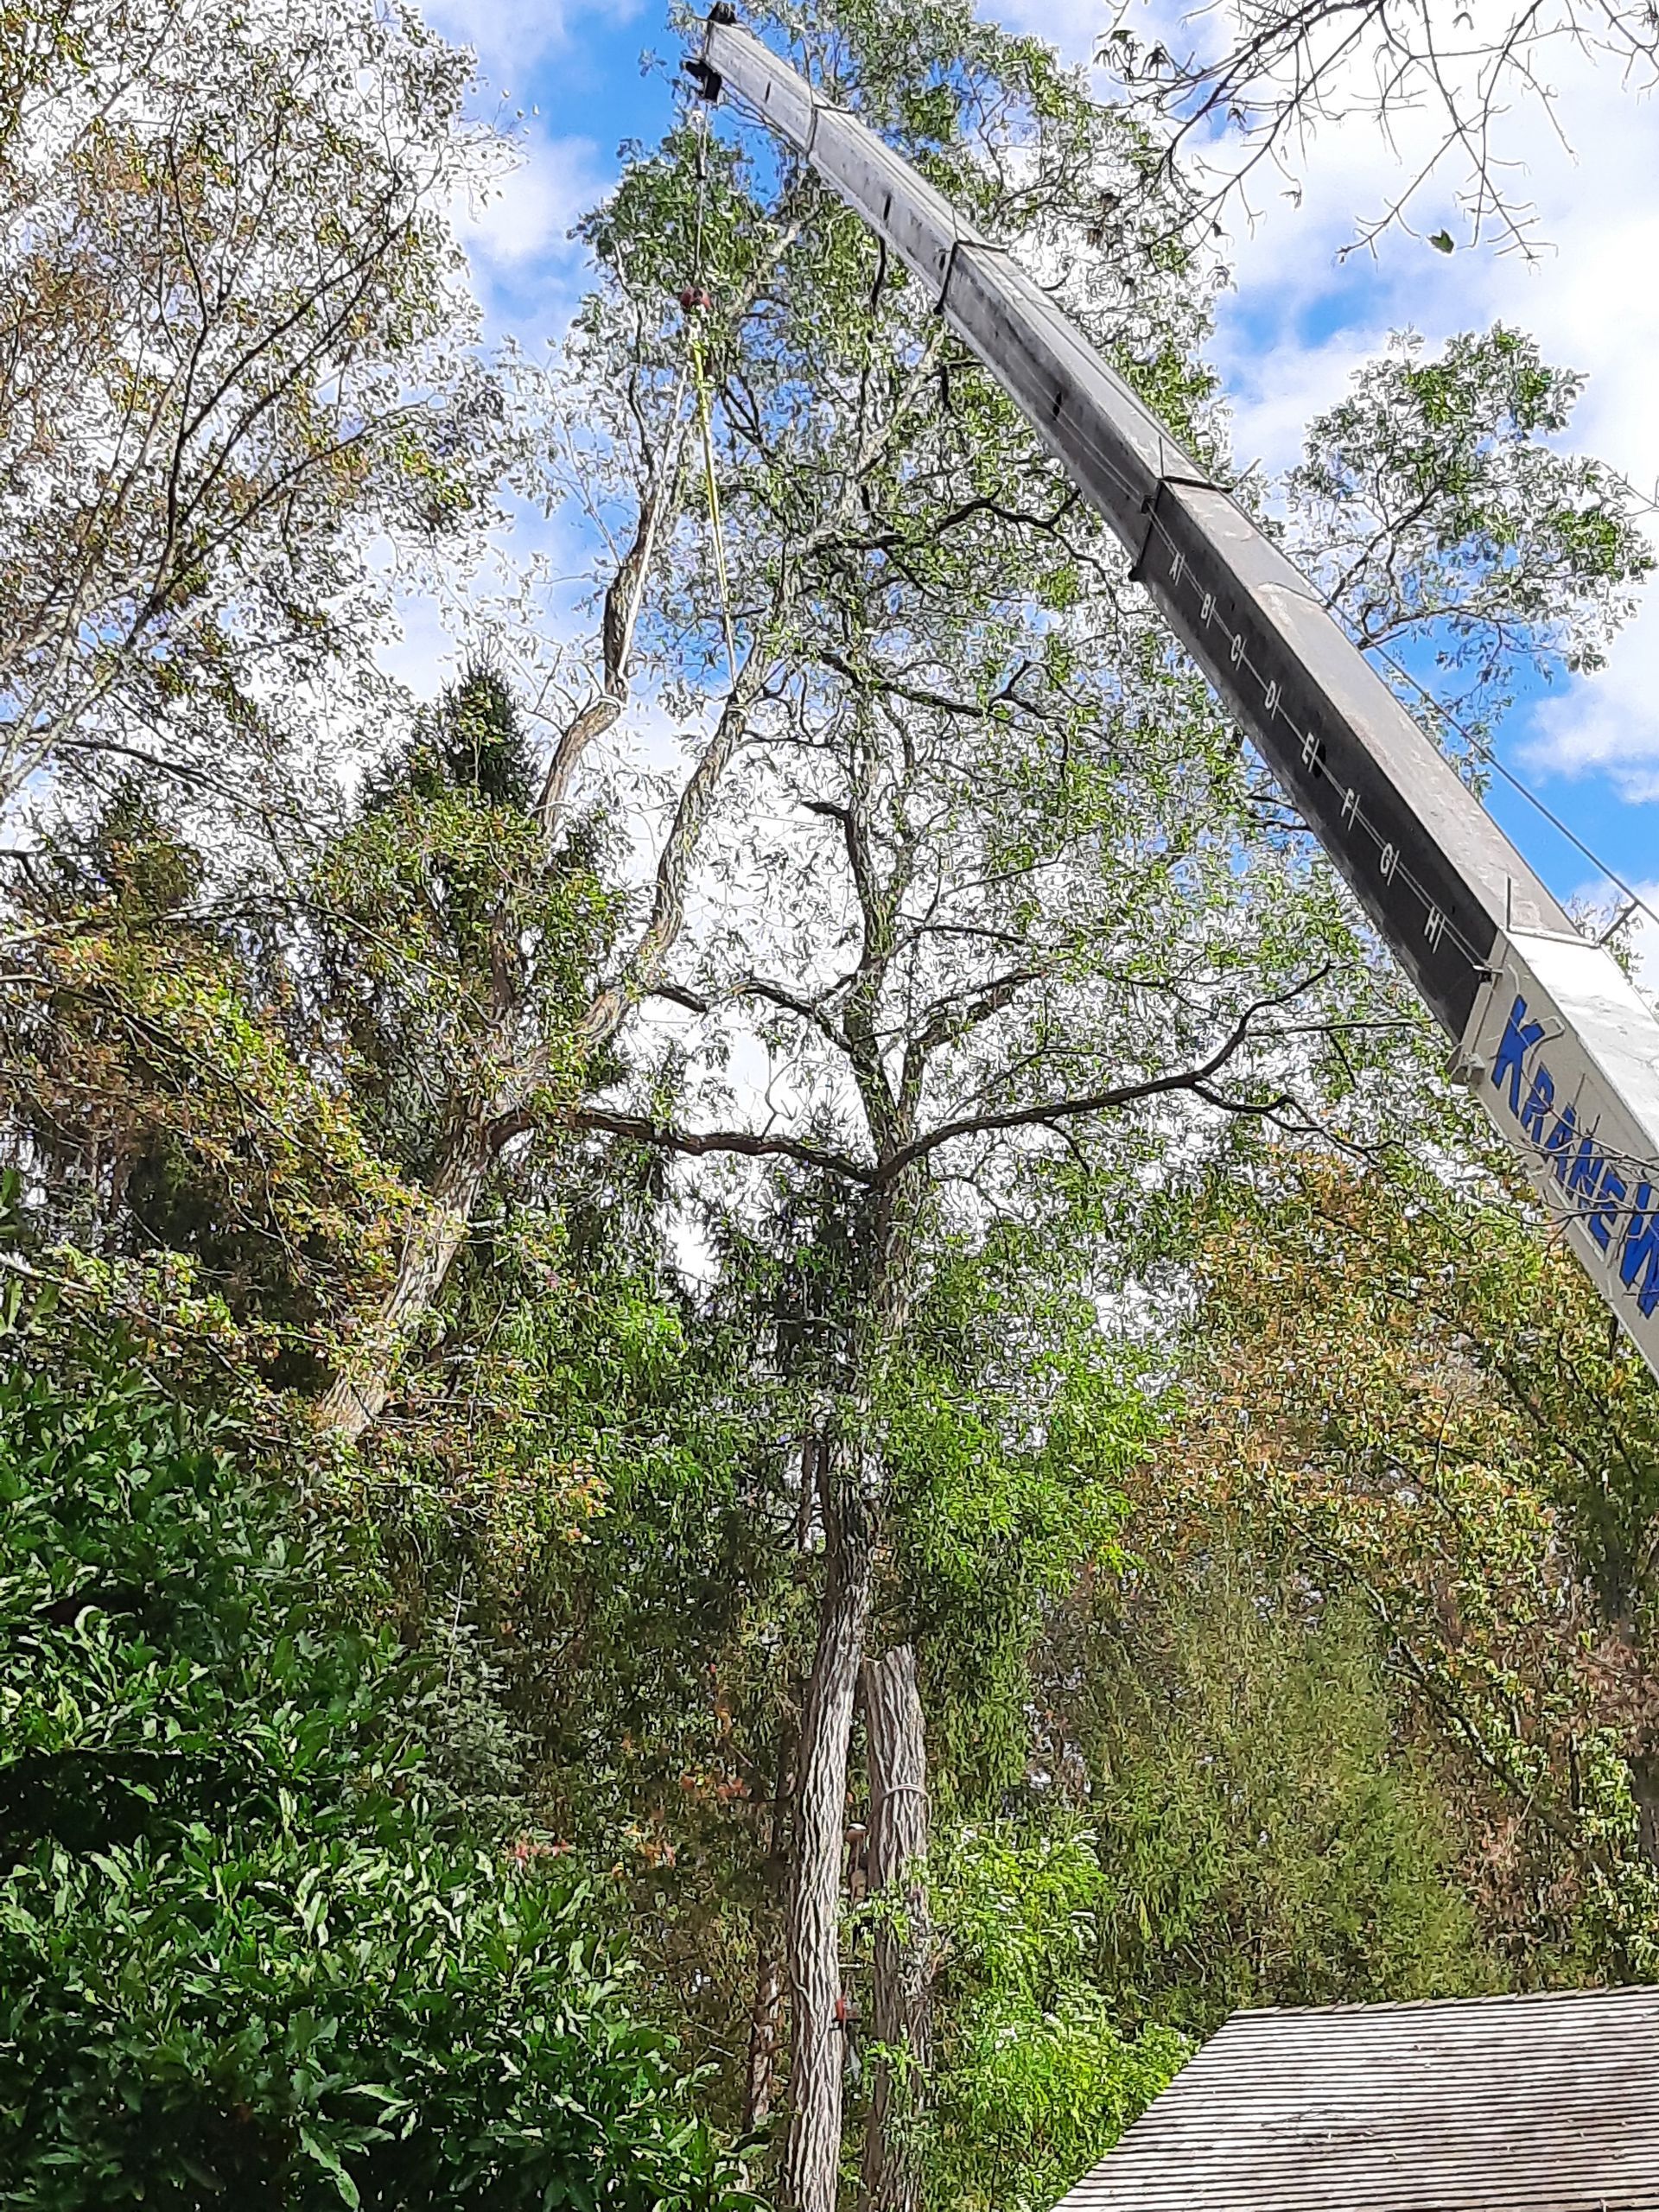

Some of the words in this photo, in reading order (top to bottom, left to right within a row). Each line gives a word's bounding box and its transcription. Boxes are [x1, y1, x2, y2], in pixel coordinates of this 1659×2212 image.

[1169, 551, 1179, 580] A
[1201, 593, 1211, 620] B
[1231, 633, 1242, 661] C
[1265, 680, 1276, 709] D
[1302, 732, 1315, 764] E
[1341, 788, 1355, 817] F
[1380, 842, 1393, 874] G
[1424, 906, 1440, 944] H
